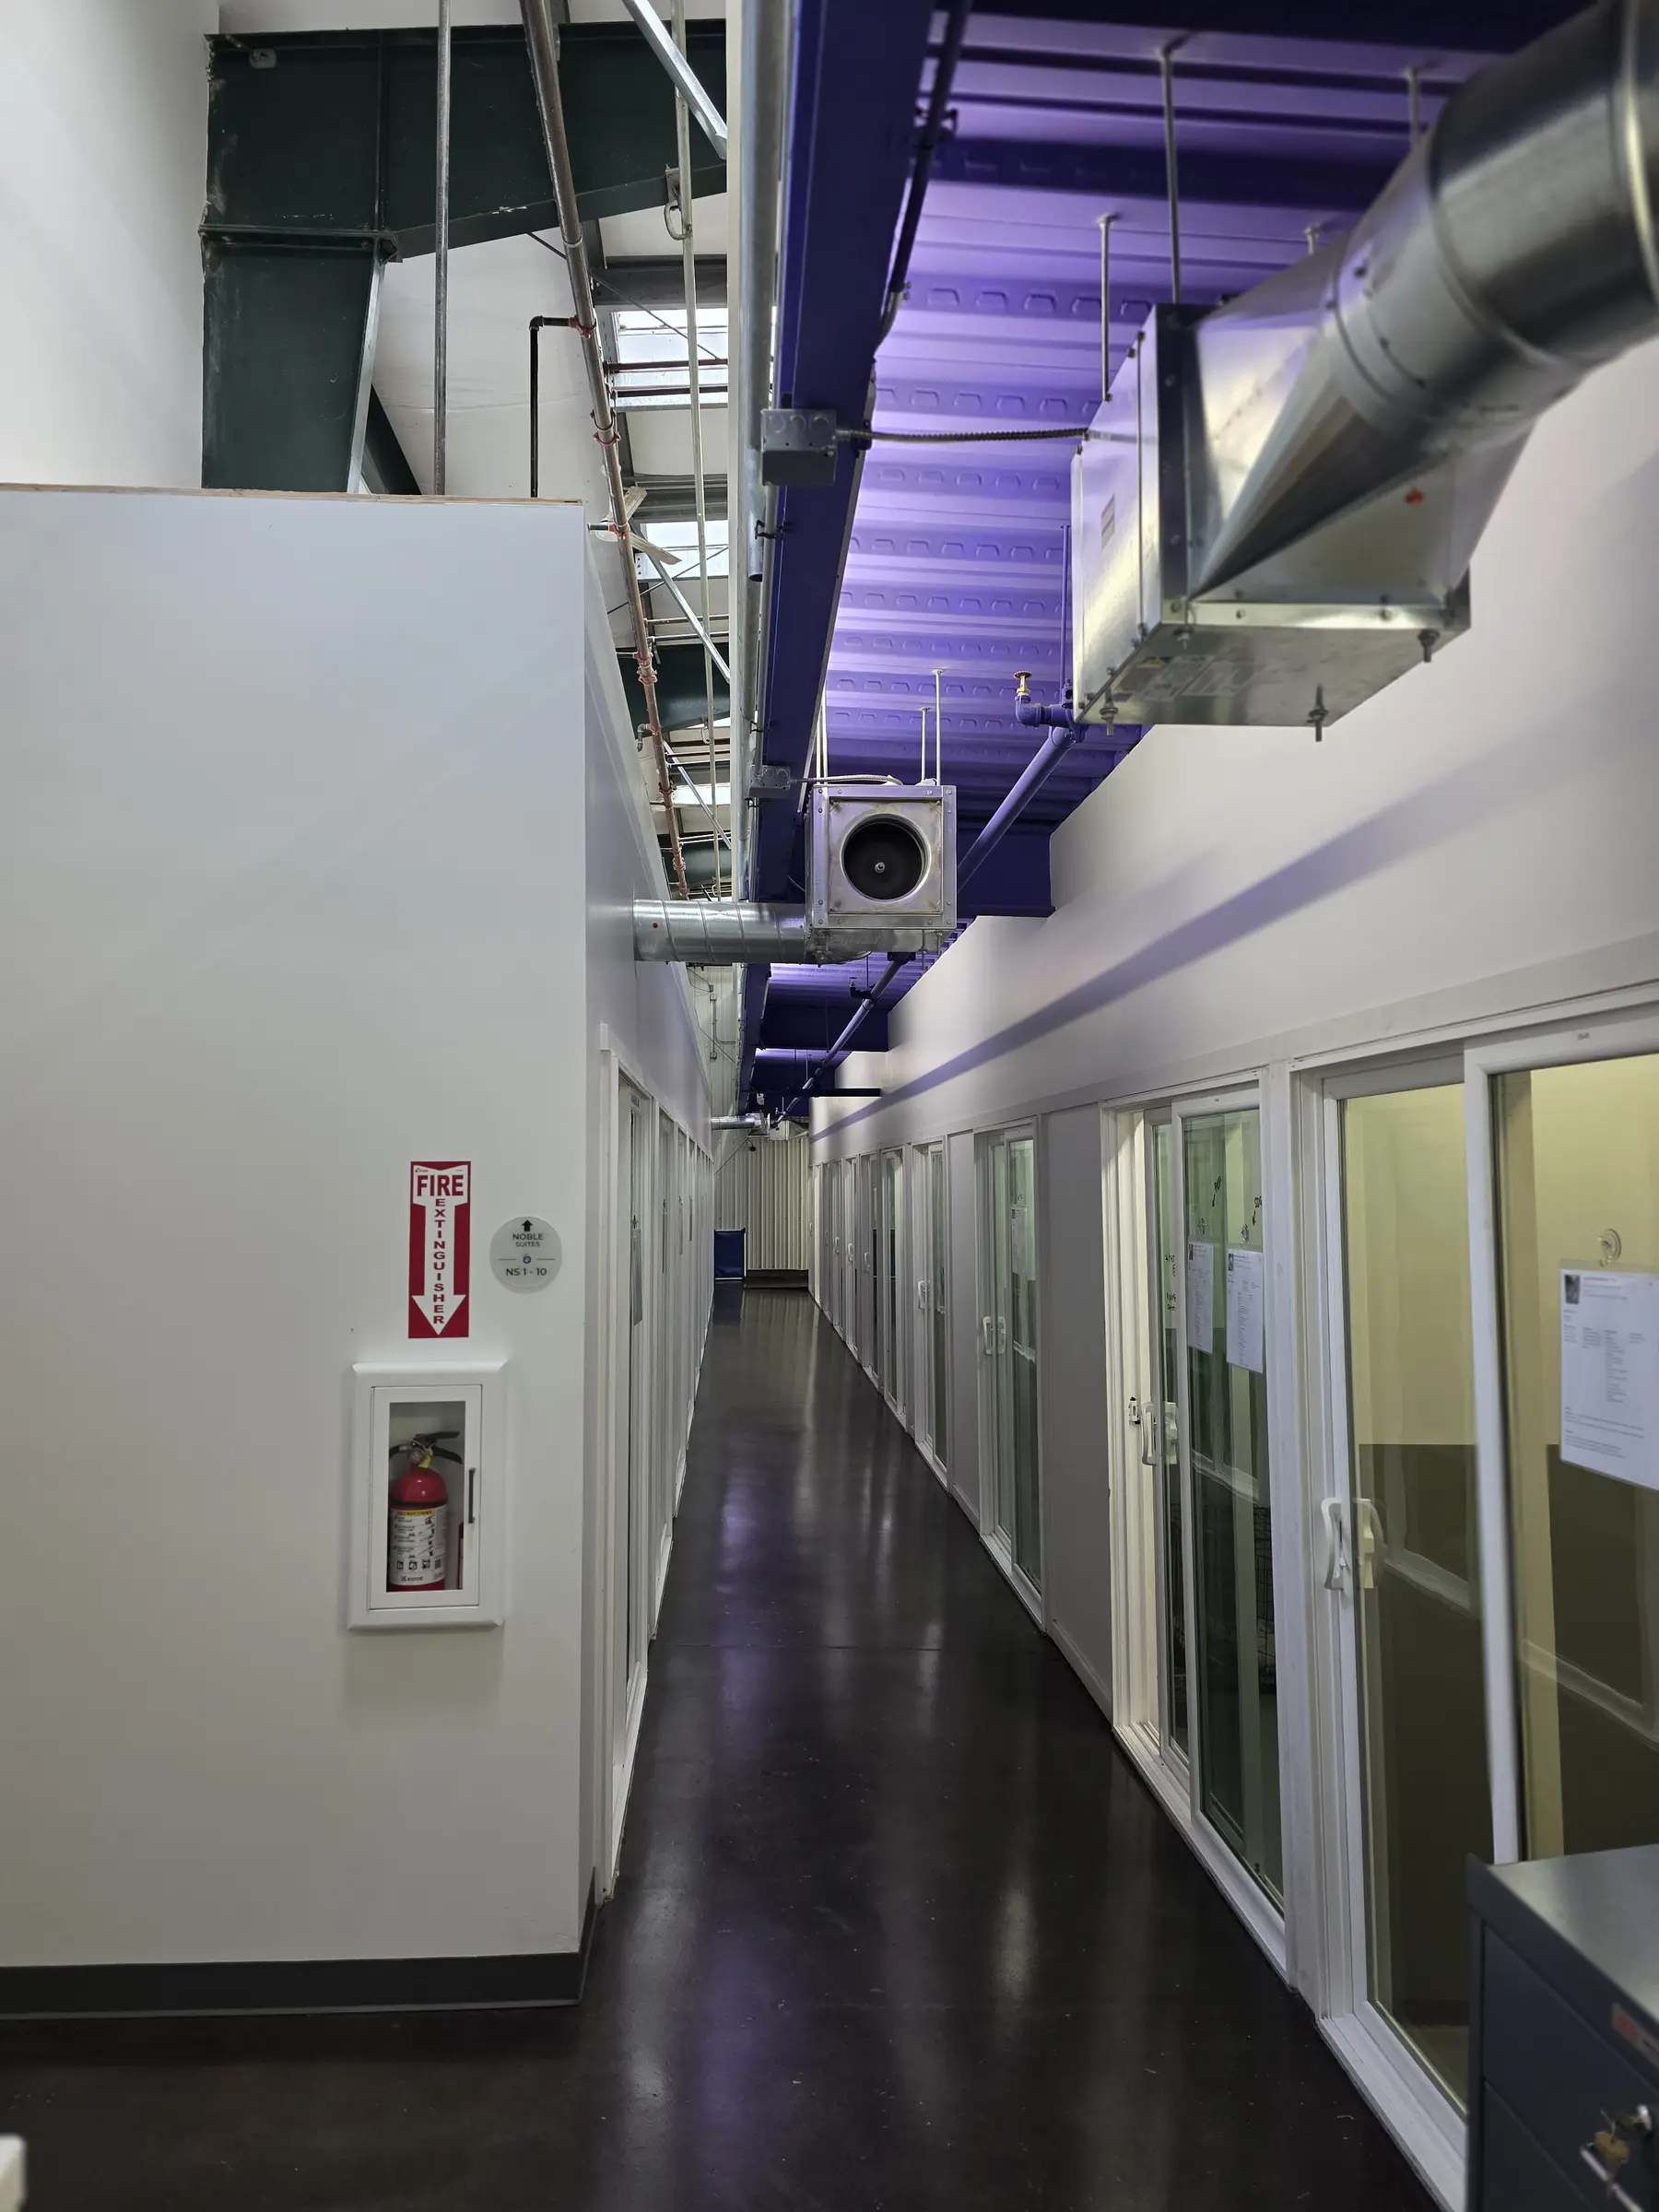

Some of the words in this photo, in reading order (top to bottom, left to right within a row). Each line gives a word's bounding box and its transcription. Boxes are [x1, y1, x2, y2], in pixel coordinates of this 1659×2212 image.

[417, 1174, 464, 1196] FIRE
[433, 1198, 445, 1324] EXTINGUISHER
[506, 1267, 520, 1276] NS
[536, 1267, 547, 1276] 10
